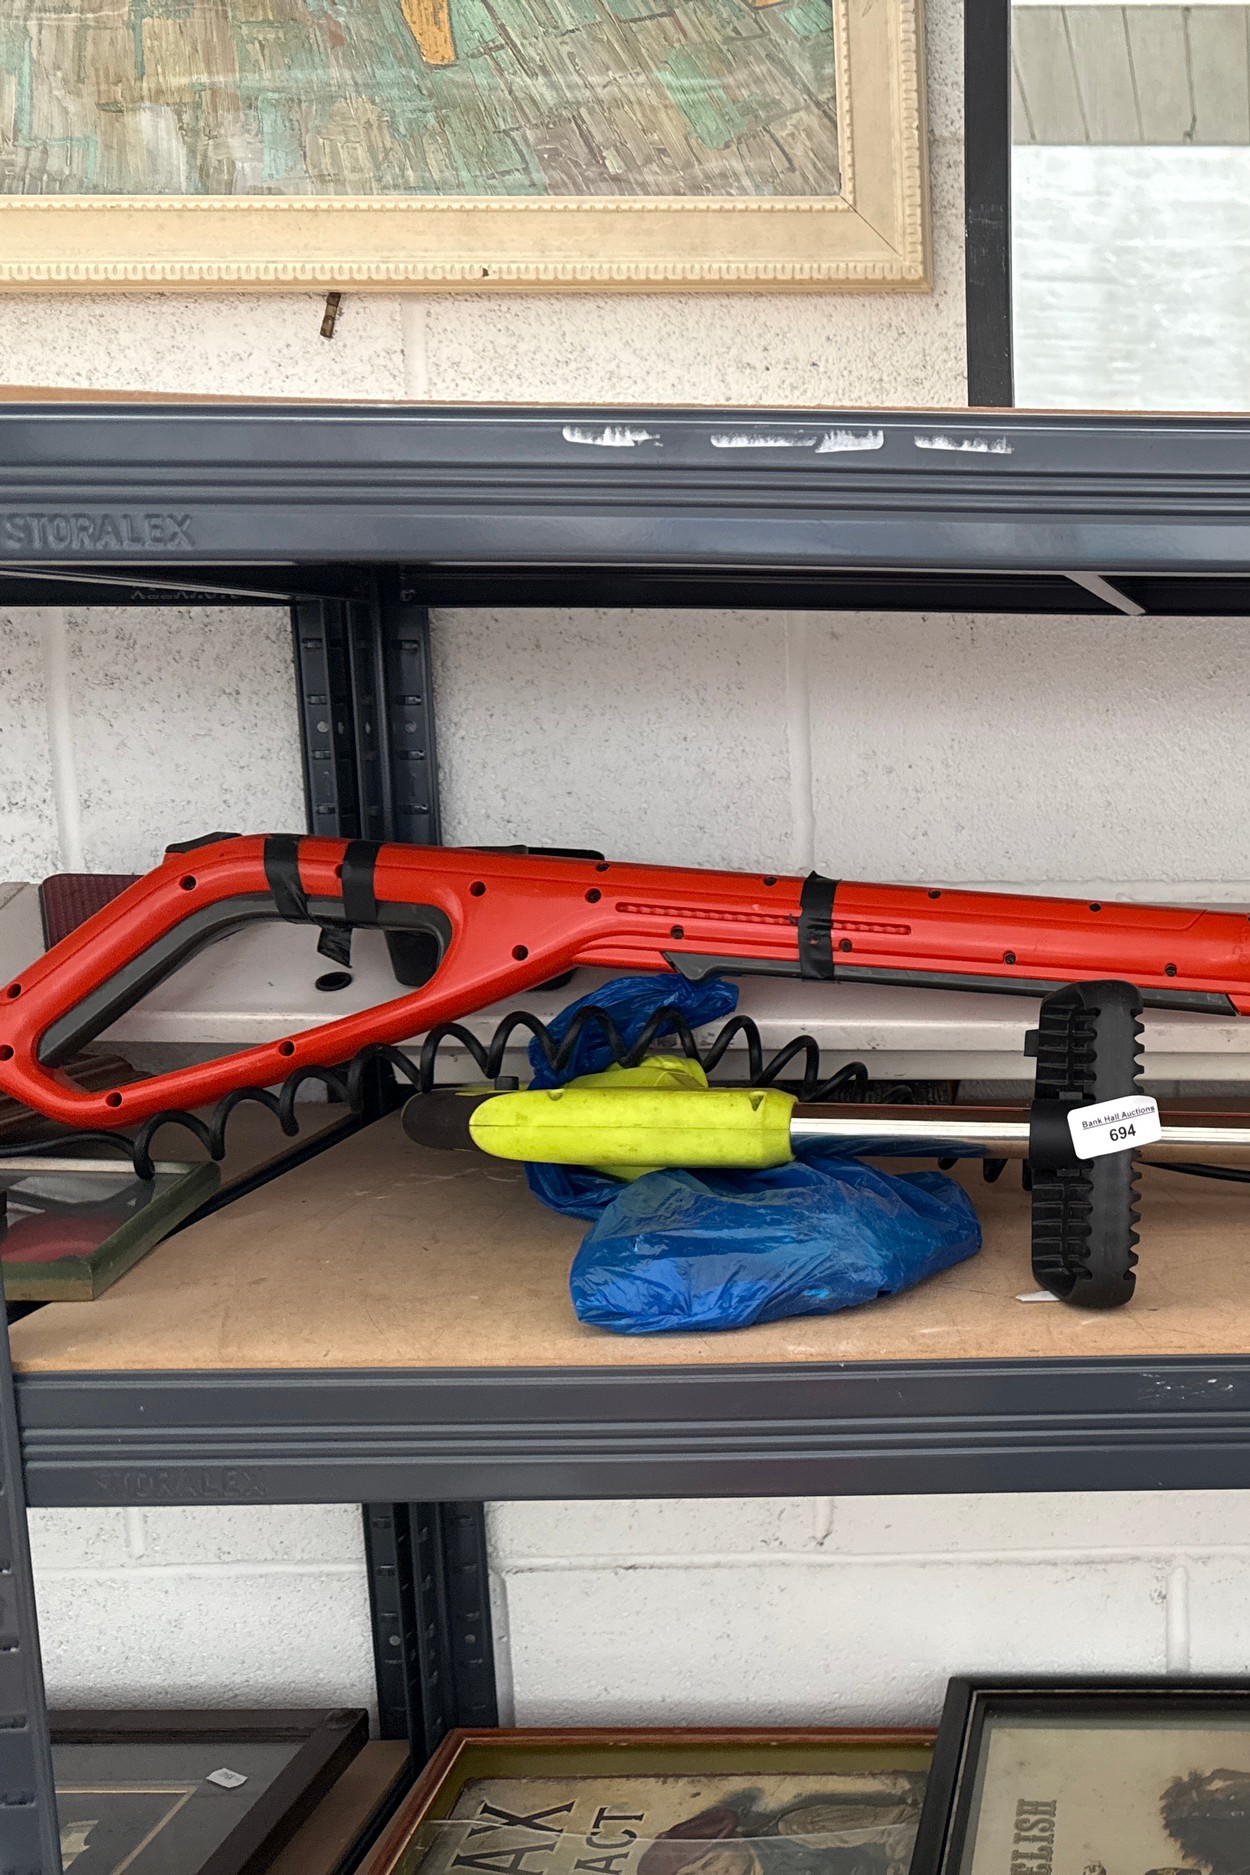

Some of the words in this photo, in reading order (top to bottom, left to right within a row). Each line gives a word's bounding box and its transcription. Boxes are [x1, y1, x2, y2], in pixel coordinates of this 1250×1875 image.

[4, 512, 196, 551] STORALEX
[1082, 1118, 1103, 1129] Bank
[1104, 1113, 1120, 1123] Hall
[1121, 1105, 1155, 1119] Auctions
[1109, 1123, 1136, 1142] 694
